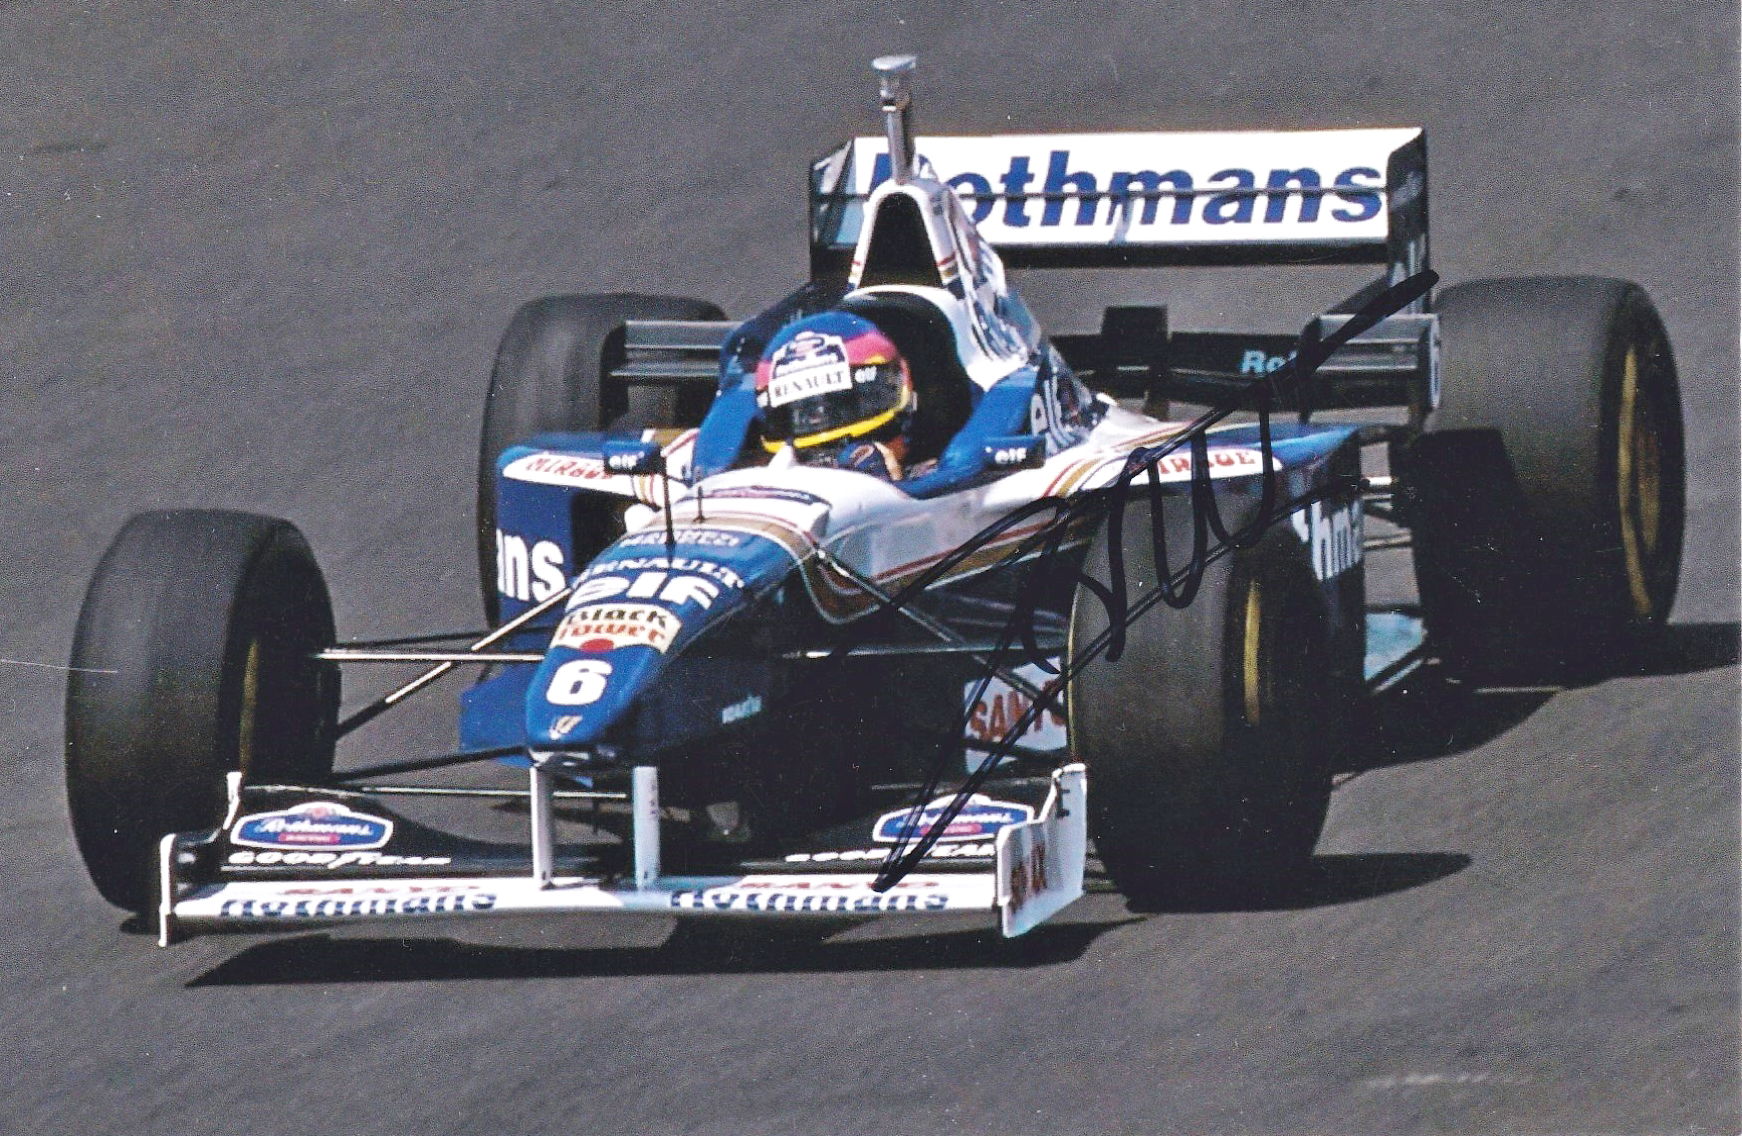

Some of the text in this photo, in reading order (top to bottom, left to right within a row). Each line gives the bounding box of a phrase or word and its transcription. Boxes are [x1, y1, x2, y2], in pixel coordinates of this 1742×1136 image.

[1239, 348, 1298, 377] Ro
[997, 446, 1028, 465] elf
[564, 571, 720, 611] elf
[546, 659, 614, 706] 6
[968, 679, 1066, 742] SANY
